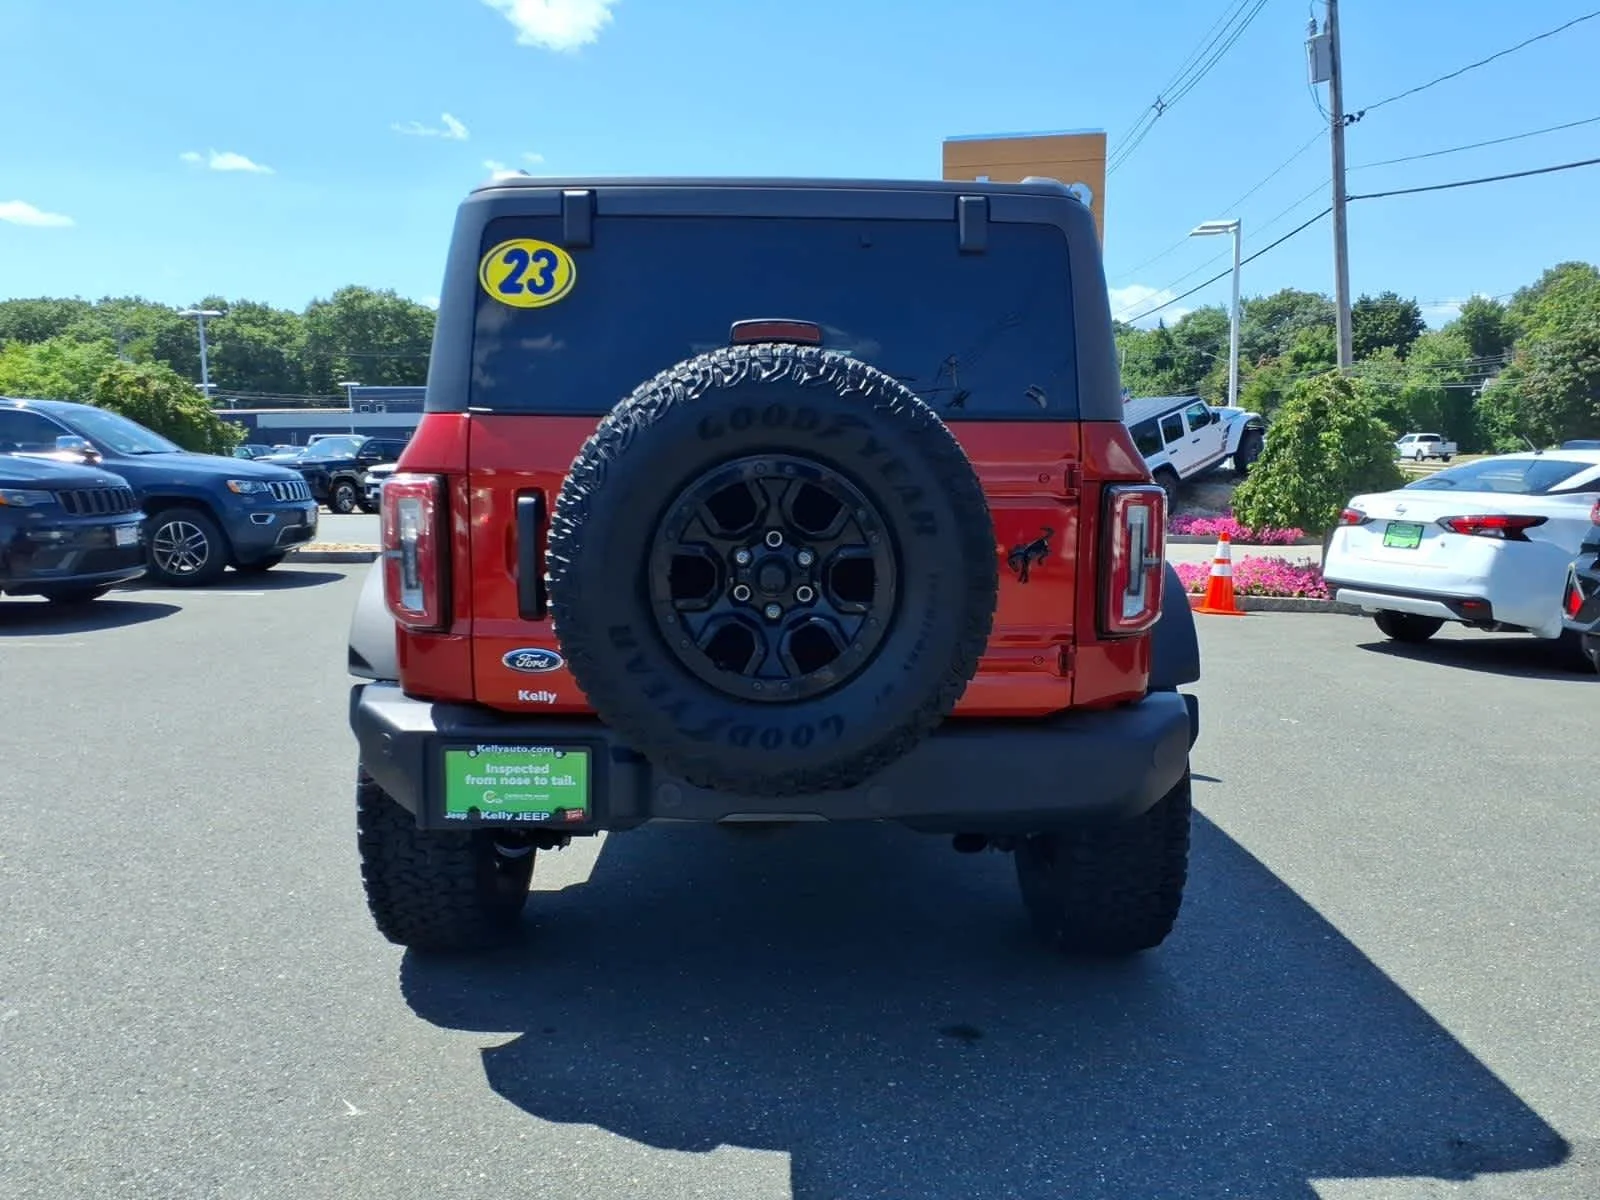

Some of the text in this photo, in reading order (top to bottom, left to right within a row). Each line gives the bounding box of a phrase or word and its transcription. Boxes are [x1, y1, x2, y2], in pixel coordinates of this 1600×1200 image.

[498, 247, 558, 295] 23
[515, 653, 550, 668] Ford
[518, 689, 557, 704] Kelly
[476, 744, 554, 754] Kellyauto.com
[485, 763, 550, 776] Inspected
[465, 774, 576, 786] from nose to tail.
[444, 811, 468, 820] Jeep
[480, 811, 550, 821] Kelly JEEP
